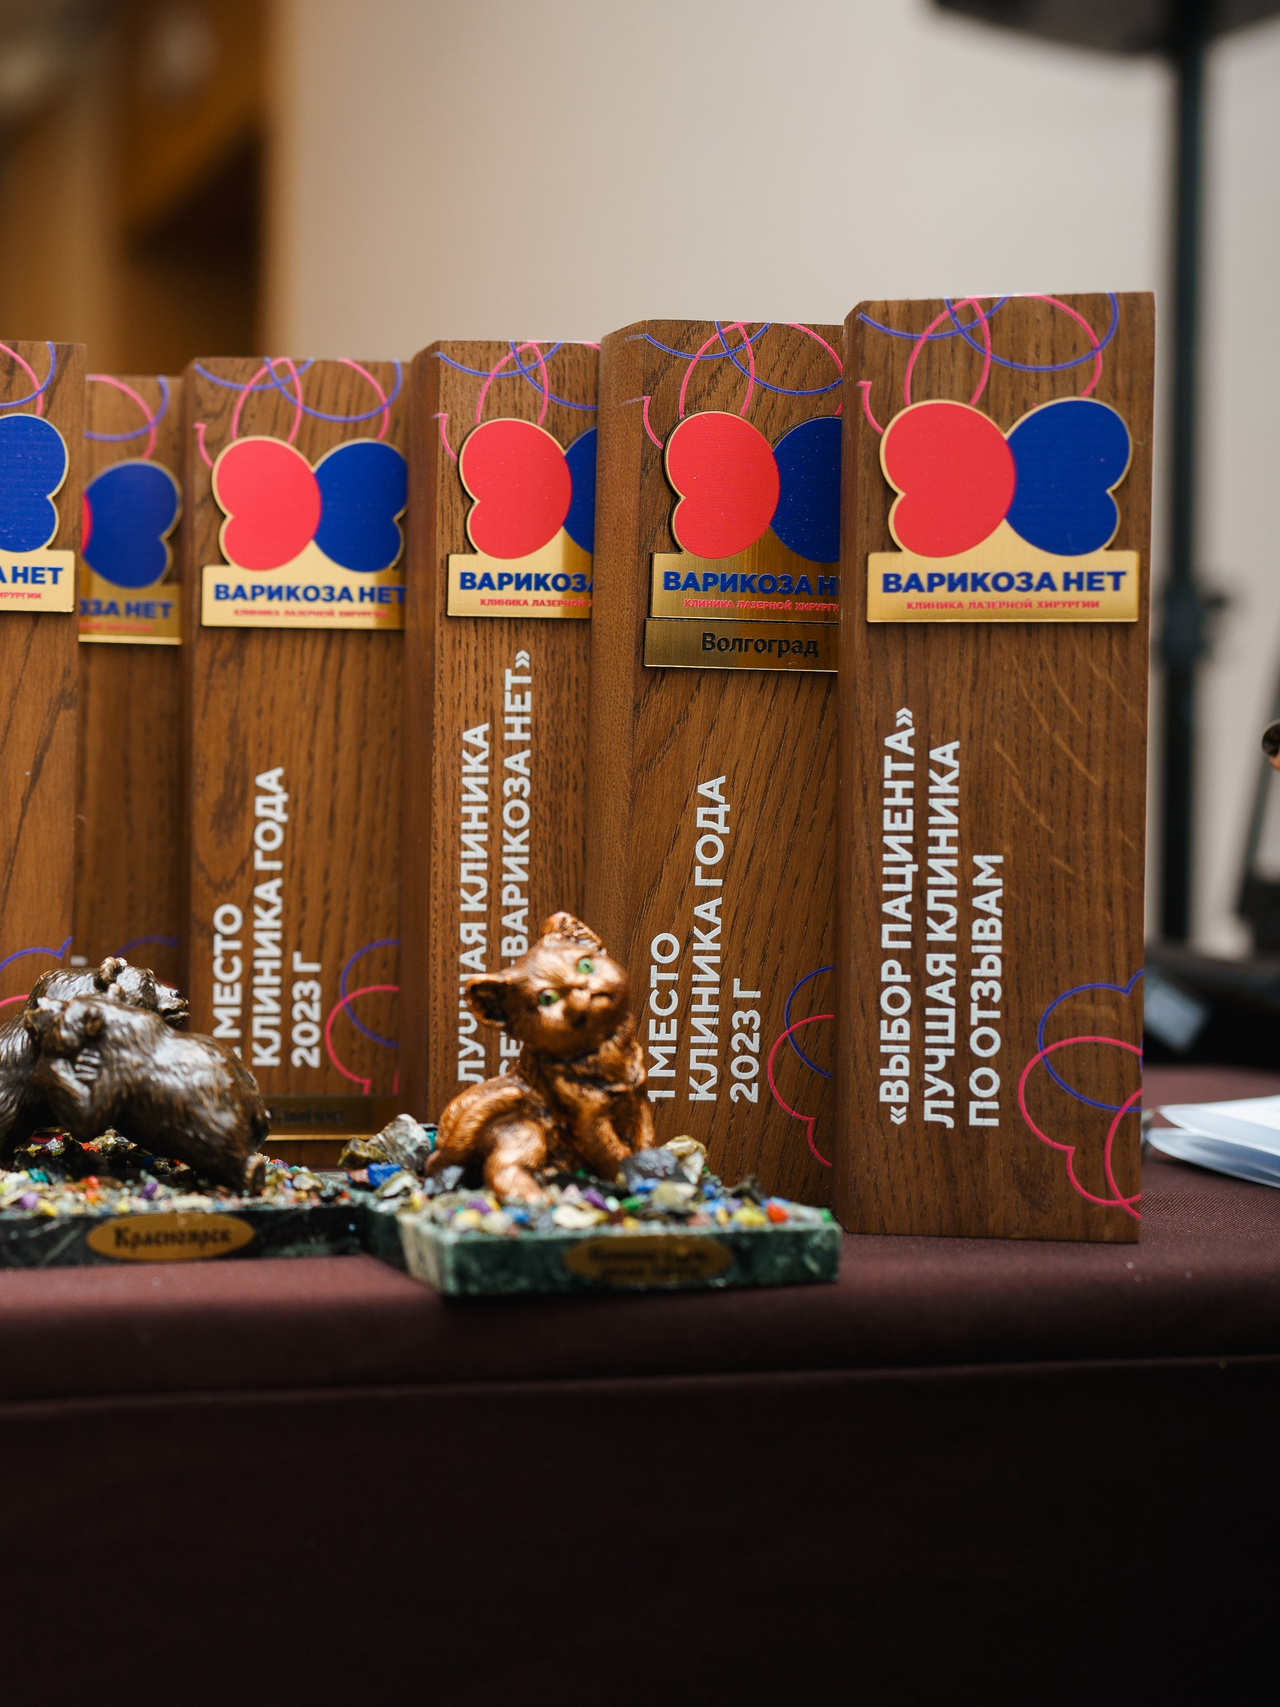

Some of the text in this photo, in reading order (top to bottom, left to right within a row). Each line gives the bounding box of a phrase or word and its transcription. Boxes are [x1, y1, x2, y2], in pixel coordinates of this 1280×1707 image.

[11, 566, 64, 585] НЕТ
[214, 584, 406, 604] ВАРИКОЗА НЕТ
[480, 598, 529, 607] КЛИНИКА
[531, 597, 587, 608] ЛАЗЕРНОЙ
[663, 570, 813, 595] ВАРИКОЗА
[684, 599, 839, 612] КЛИНИКА ЛАЗЕРНОЙ ХИРУРГИ
[882, 571, 1127, 593] ВАРИКОЗА НЕТ
[906, 599, 1100, 611] КЛИНИКА ЛАЗЕРНОЙ ХИРУРГИИ
[702, 632, 819, 659] Волгоград
[460, 722, 489, 911] КЛИНИКА
[501, 650, 532, 963] ВАРИКОЗА НЕТ»
[212, 903, 243, 1038] МЕСТО
[251, 766, 289, 1066] КЛИНИКА ГОДА
[689, 775, 730, 1101] КЛИНИКА ГОДА
[879, 707, 918, 1125] «ВЫБОР ПАЦИЕНТА»
[923, 740, 960, 1128] ЛУЧШАЯ КЛИНИКА
[290, 951, 321, 1068] 2023 Г
[647, 932, 680, 1103] 1 МЕСТО
[729, 978, 761, 1103] 2023 Г
[969, 855, 1004, 1126] ПО ОТЗЫВАМ
